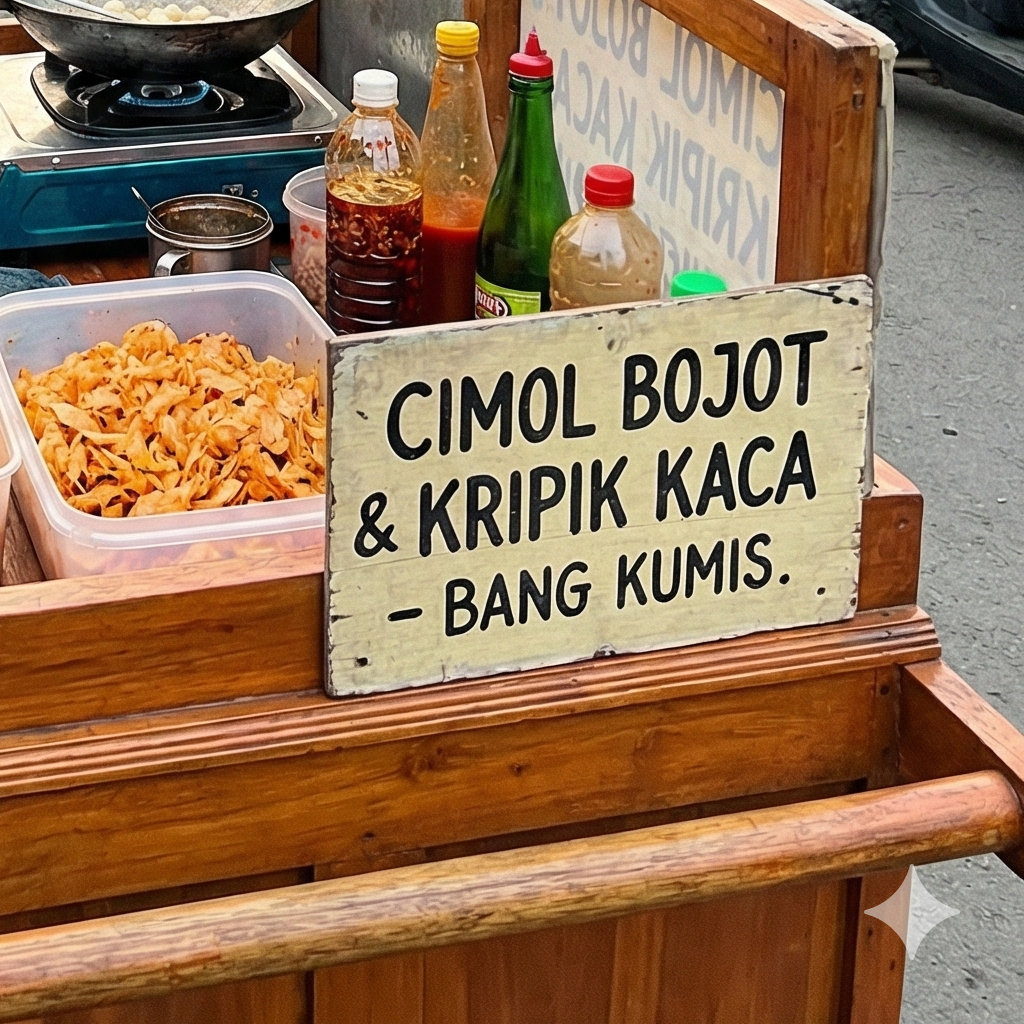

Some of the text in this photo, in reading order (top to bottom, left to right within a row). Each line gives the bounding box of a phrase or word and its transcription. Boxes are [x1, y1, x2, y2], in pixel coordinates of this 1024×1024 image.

[386, 330, 829, 461] CIMOL BOJOT
[353, 430, 817, 558] & KRIPIK KACA
[445, 561, 592, 637] BANG
[616, 533, 791, 610] KUMIS.
